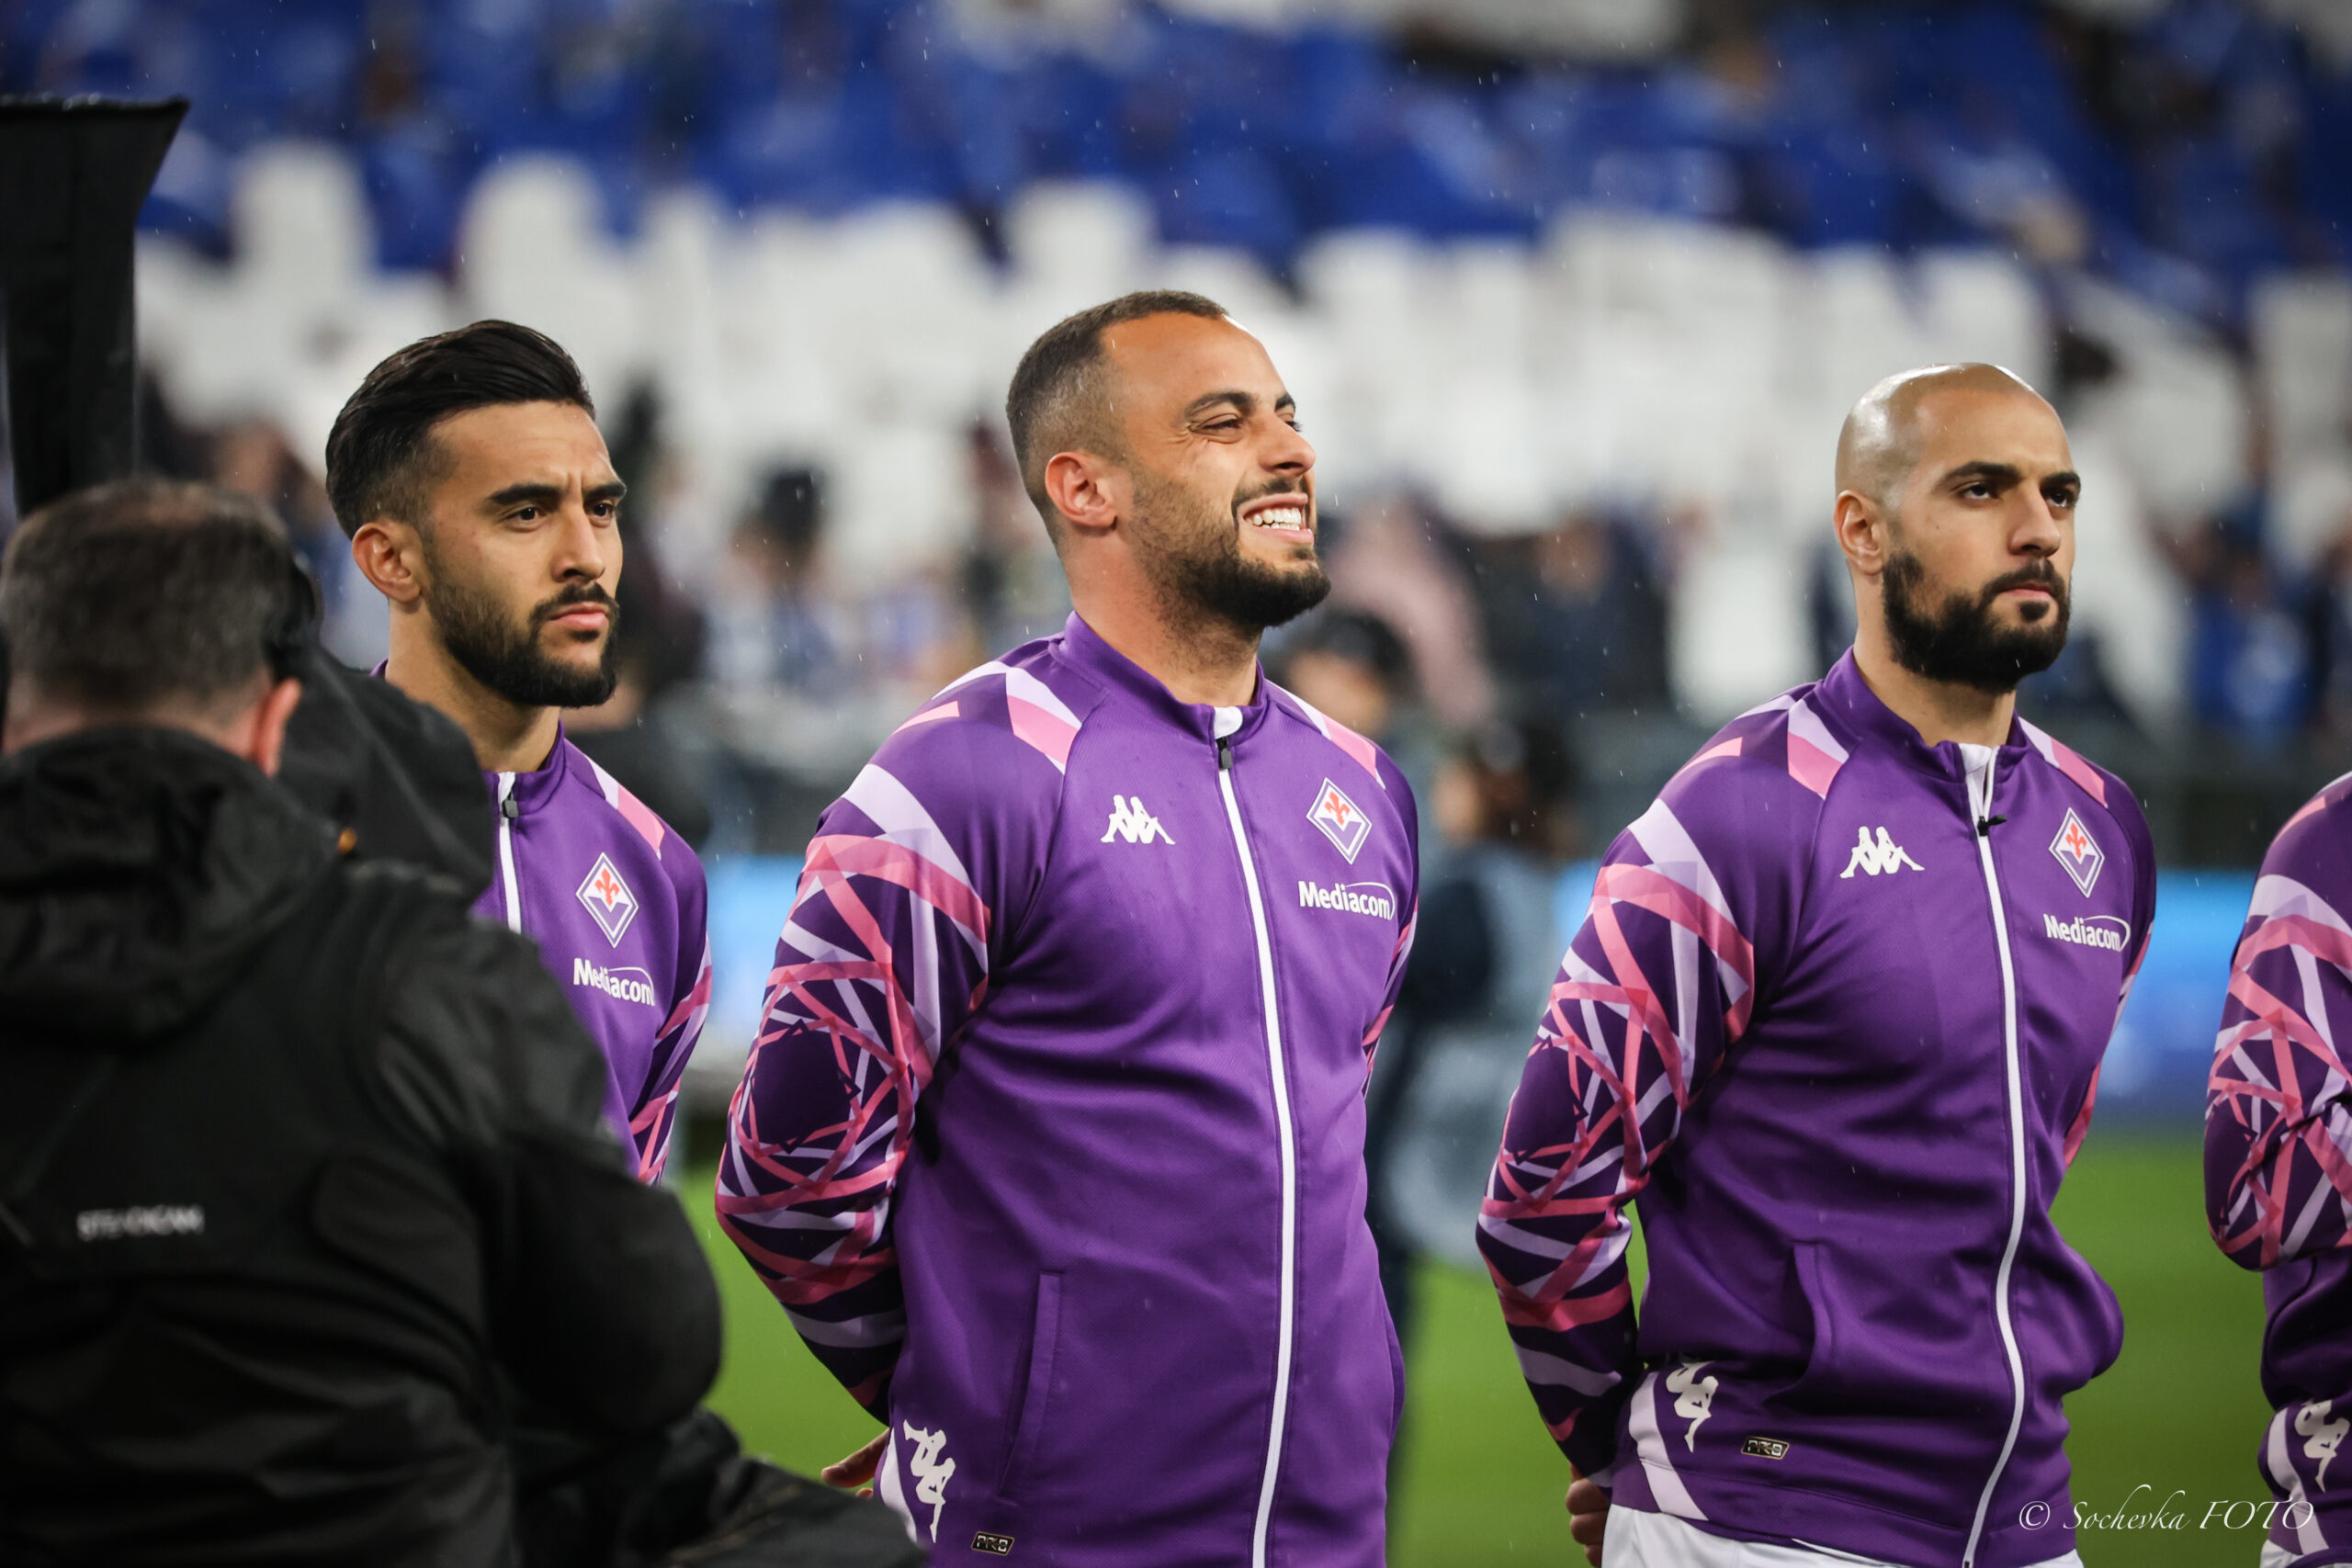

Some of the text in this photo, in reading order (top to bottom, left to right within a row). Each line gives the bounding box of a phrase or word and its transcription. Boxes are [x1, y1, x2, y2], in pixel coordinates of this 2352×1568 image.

[1297, 880, 1393, 920] Mediacom
[2042, 913, 2124, 953] Mediacom
[572, 957, 656, 1007] Mediacom
